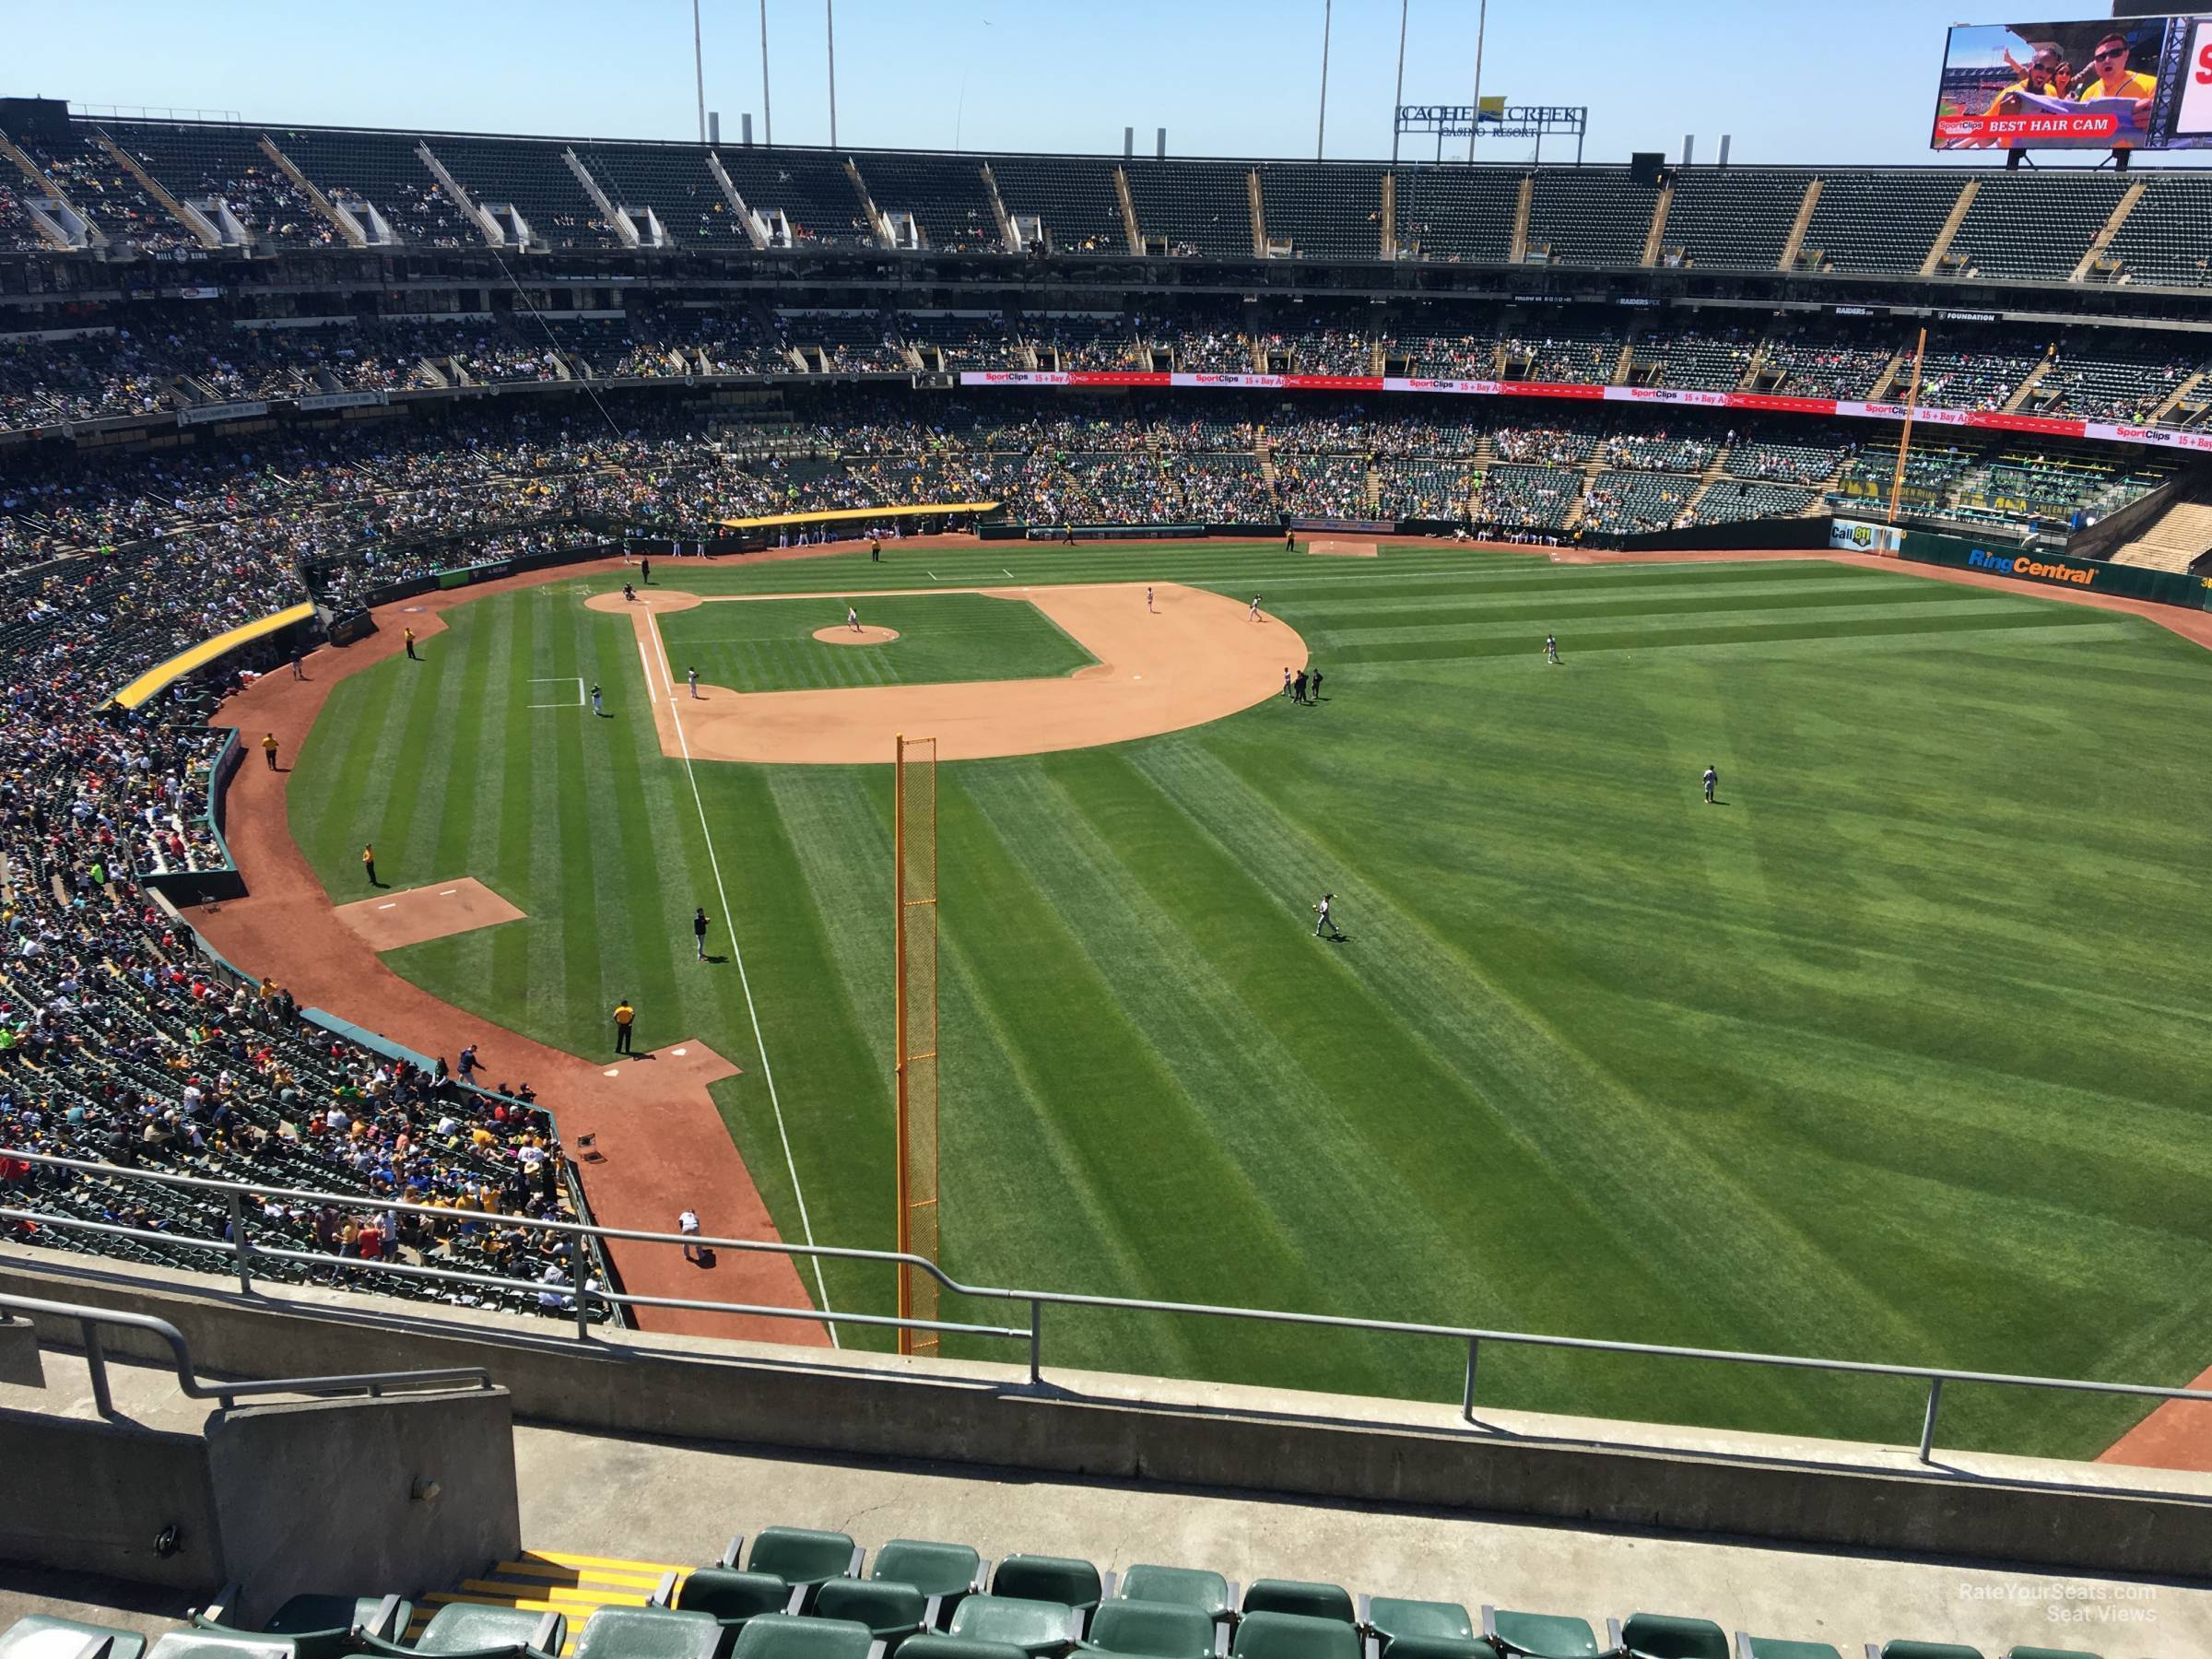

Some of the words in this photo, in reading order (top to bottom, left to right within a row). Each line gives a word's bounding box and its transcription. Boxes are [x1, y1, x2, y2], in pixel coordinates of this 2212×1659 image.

[1401, 105, 1473, 121] CACHE
[1507, 106, 1577, 123] CREEK
[1939, 120, 1983, 131] SportClips
[1989, 121, 2027, 132] BEST
[2030, 120, 2068, 132] HAIR
[2072, 119, 2109, 131] CAM
[1441, 126, 1486, 137] CASINO
[1492, 127, 1537, 137] RESORT
[1947, 312, 1995, 322] FOUNDATION
[986, 372, 1029, 382] SportClips
[1051, 374, 1063, 382] Bay
[1195, 374, 1239, 382] SportClips
[1245, 376, 1253, 384] 15
[1261, 377, 1274, 385] Bay
[1409, 380, 1453, 388] SportClips
[1460, 382, 1468, 391] 15
[1477, 383, 1489, 392] Bay
[1630, 388, 1677, 399] SportClips
[1684, 393, 1693, 402] 15
[1701, 394, 1716, 404] Bay
[1922, 410, 1931, 419] 15
[1939, 412, 1955, 421] Bay
[2116, 427, 2171, 441] SportClips
[2178, 435, 2188, 445] 15
[1831, 526, 1853, 540] Call
[1854, 526, 1871, 540] 811
[1968, 549, 2095, 585] RingCentral
